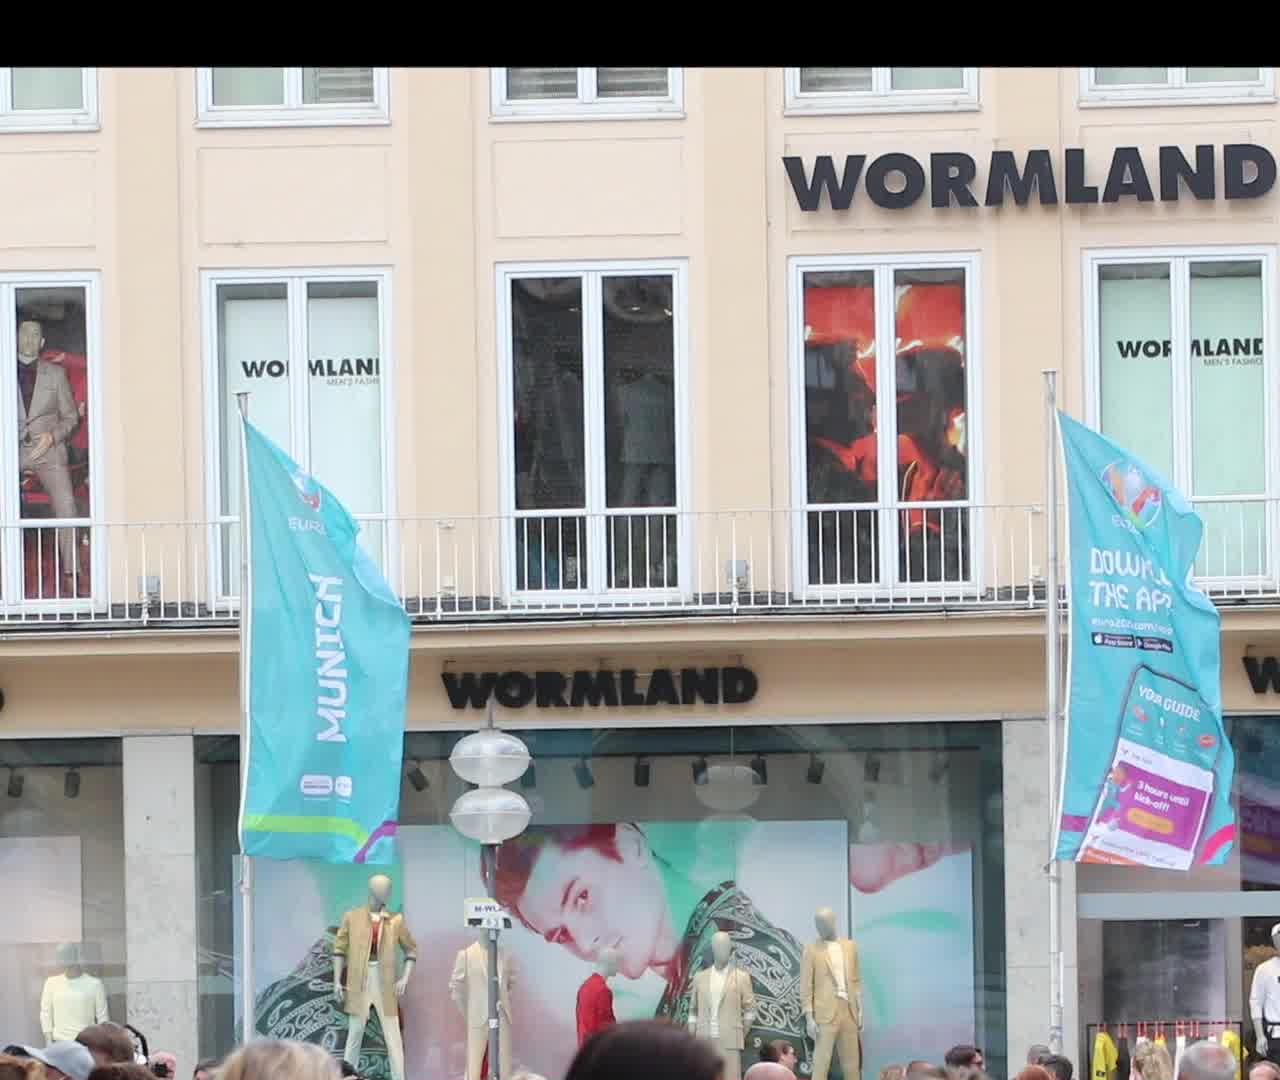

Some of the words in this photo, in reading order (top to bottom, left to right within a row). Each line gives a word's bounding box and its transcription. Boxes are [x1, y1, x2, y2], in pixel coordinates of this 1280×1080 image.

[782, 143, 1278, 212] WORMLAND
[308, 572, 348, 743] MUNICH
[441, 666, 759, 709] WORMLAND
